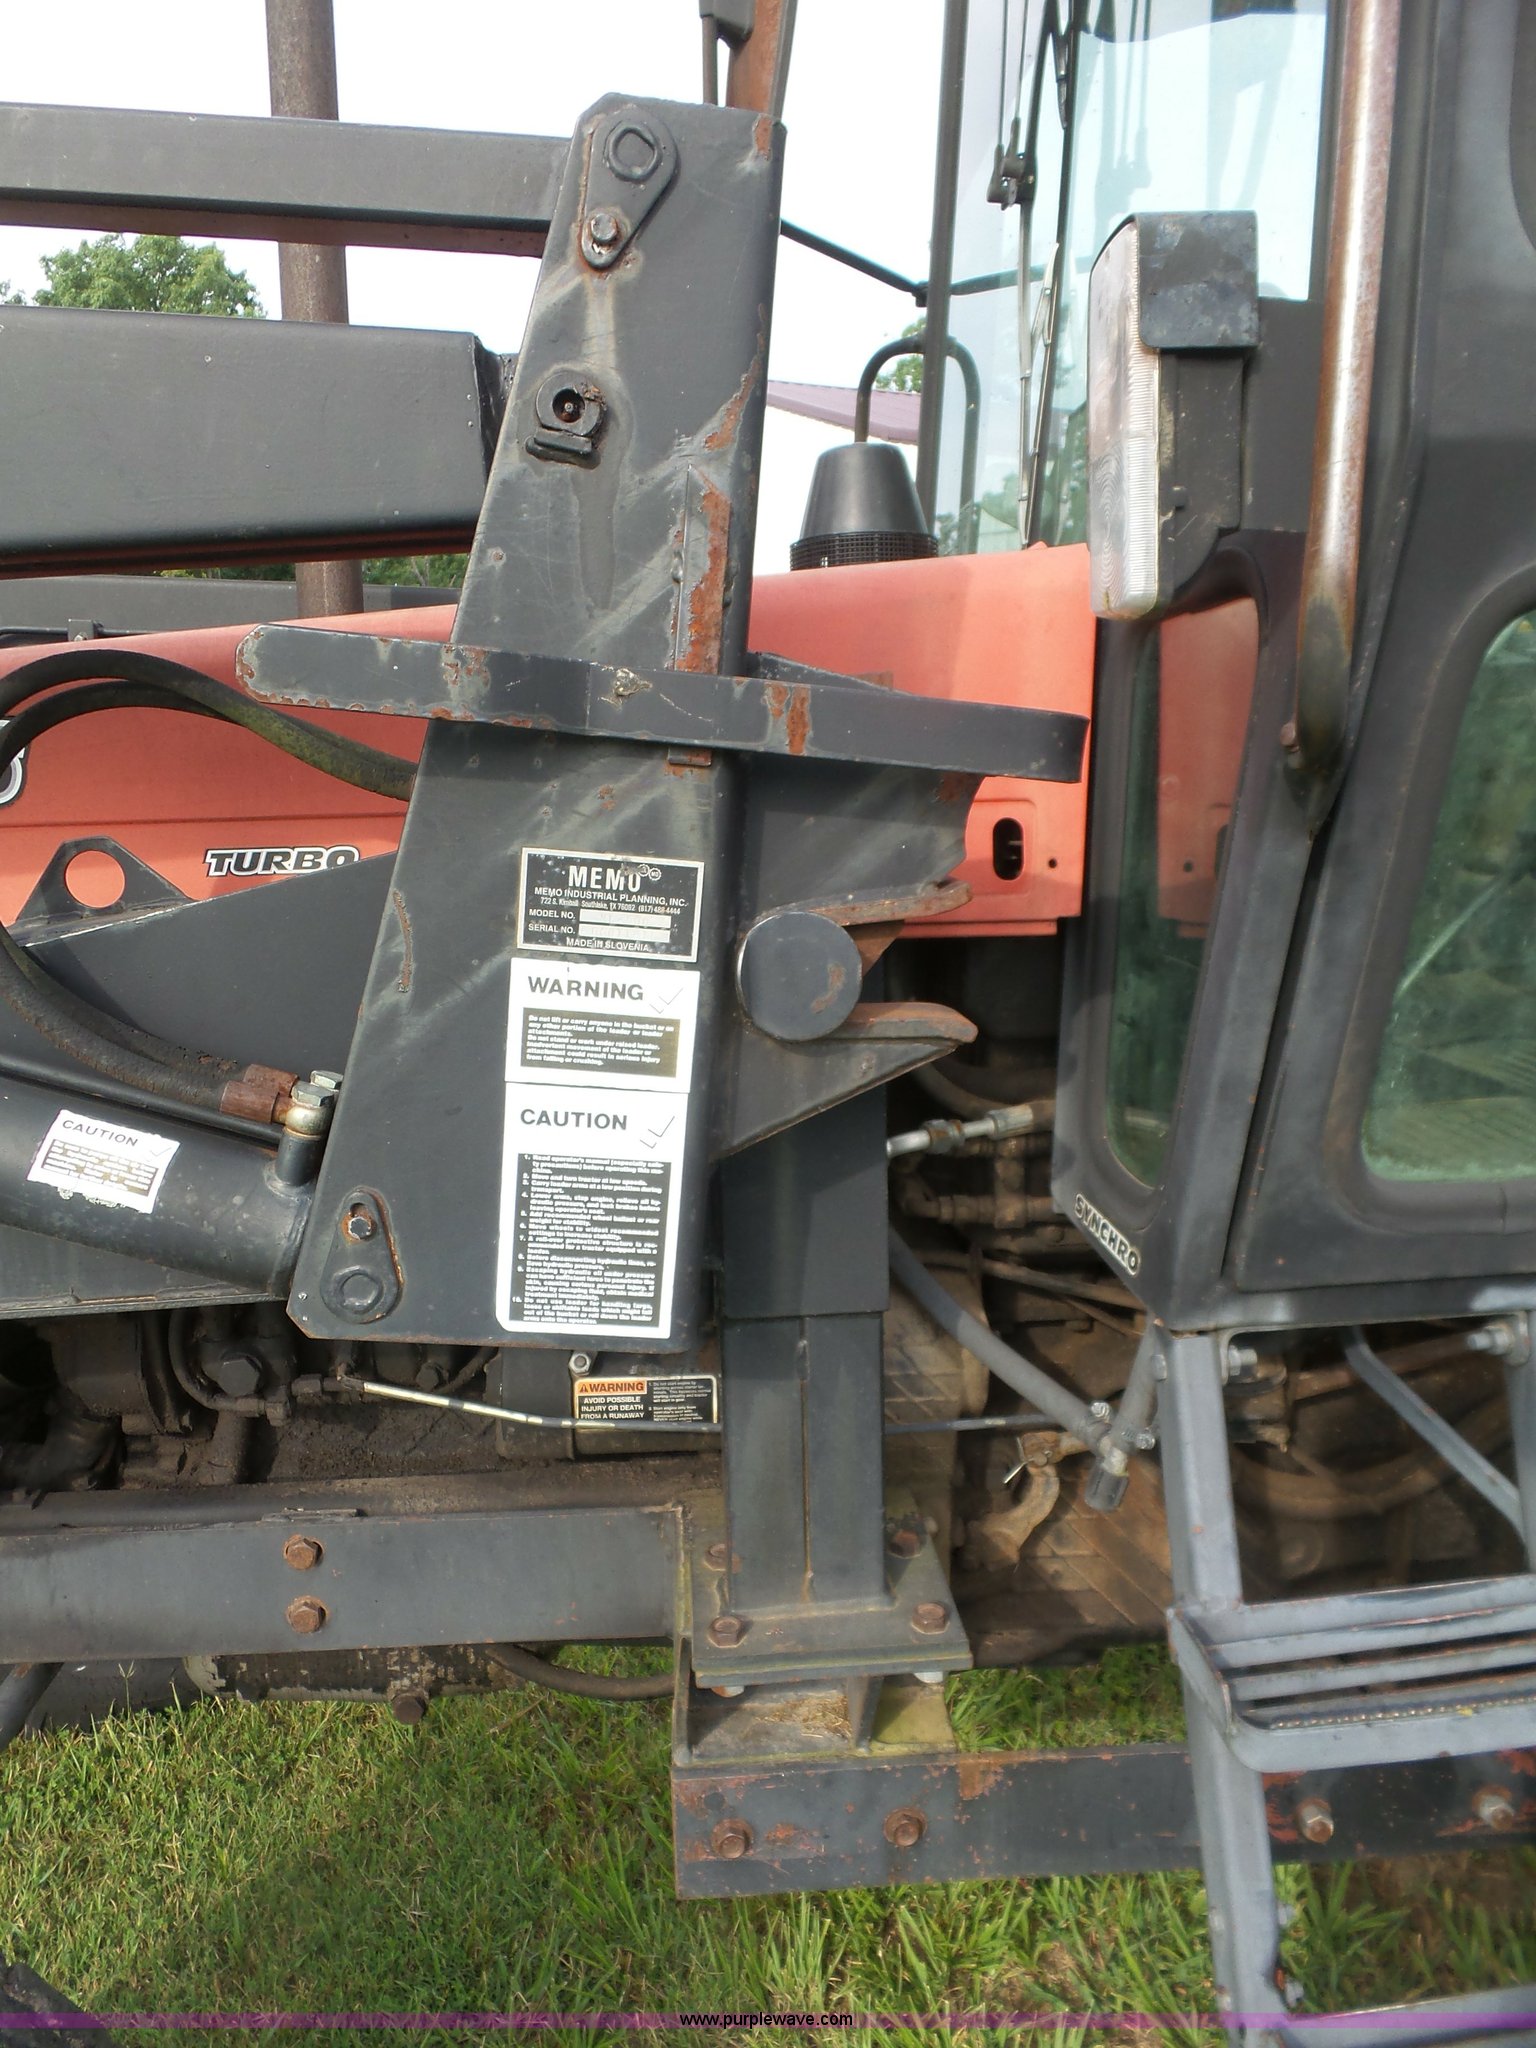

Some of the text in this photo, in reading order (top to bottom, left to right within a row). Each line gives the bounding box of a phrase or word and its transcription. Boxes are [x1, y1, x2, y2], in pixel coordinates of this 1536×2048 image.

[203, 845, 361, 877] TURBO
[568, 865, 641, 892] MEMO
[534, 886, 688, 907] MEMO INDUSTRIAL PLANNING, INC.
[540, 897, 551, 905] 722
[529, 908, 576, 920] MODEL NO.
[528, 923, 576, 934] SERIAL NO.
[566, 937, 650, 952] MADE IN SLOVENIA
[528, 975, 644, 1001] WARNING
[520, 1108, 627, 1131] CAUTION
[62, 1119, 138, 1147] CAUTION
[1075, 1194, 1140, 1275] SYNCHRO
[589, 1382, 644, 1393] WARNING
[583, 1395, 641, 1404] AVOID POSSIBLE
[608, 1404, 619, 1412] OR
[580, 1412, 601, 1420] FROM
